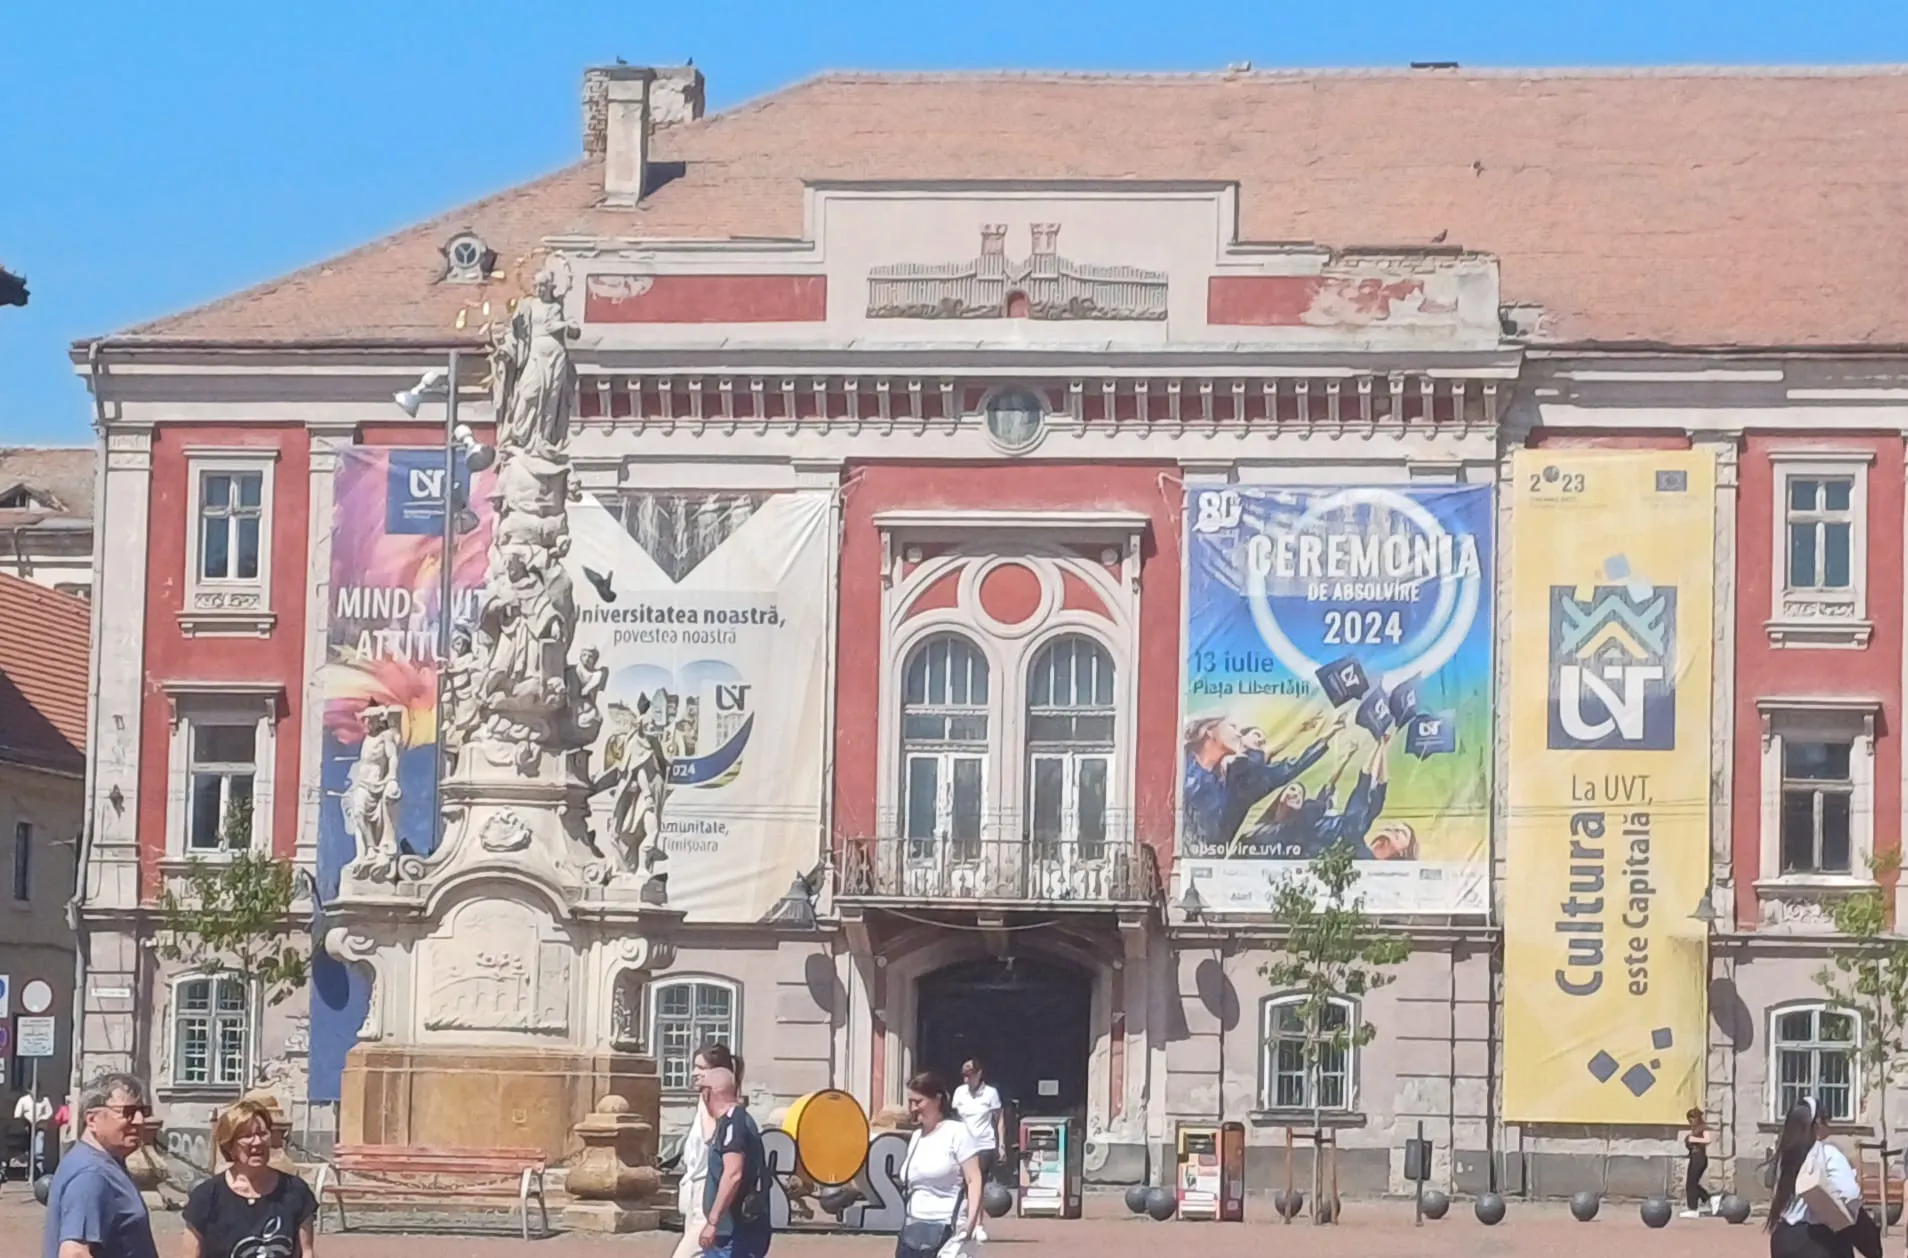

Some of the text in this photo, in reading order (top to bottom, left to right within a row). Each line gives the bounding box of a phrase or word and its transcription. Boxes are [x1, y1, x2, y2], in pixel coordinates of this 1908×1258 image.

[1248, 532, 1483, 579] CEREMONIA
[337, 586, 427, 619] MINDS
[1307, 581, 1420, 603] DE ABSOLVIRE
[703, 605, 786, 628] noastră,
[1323, 610, 1403, 645] 2024
[613, 628, 737, 647] povestea noastră
[1194, 650, 1274, 673] 13 iulie
[715, 684, 752, 711] UVT
[1559, 664, 1664, 741] UVT
[672, 763, 696, 777] 024
[1572, 774, 1653, 806] La UVT,
[660, 819, 729, 837] omunitate,
[1554, 811, 1606, 997] Cultura
[1621, 811, 1657, 997] este Capitală
